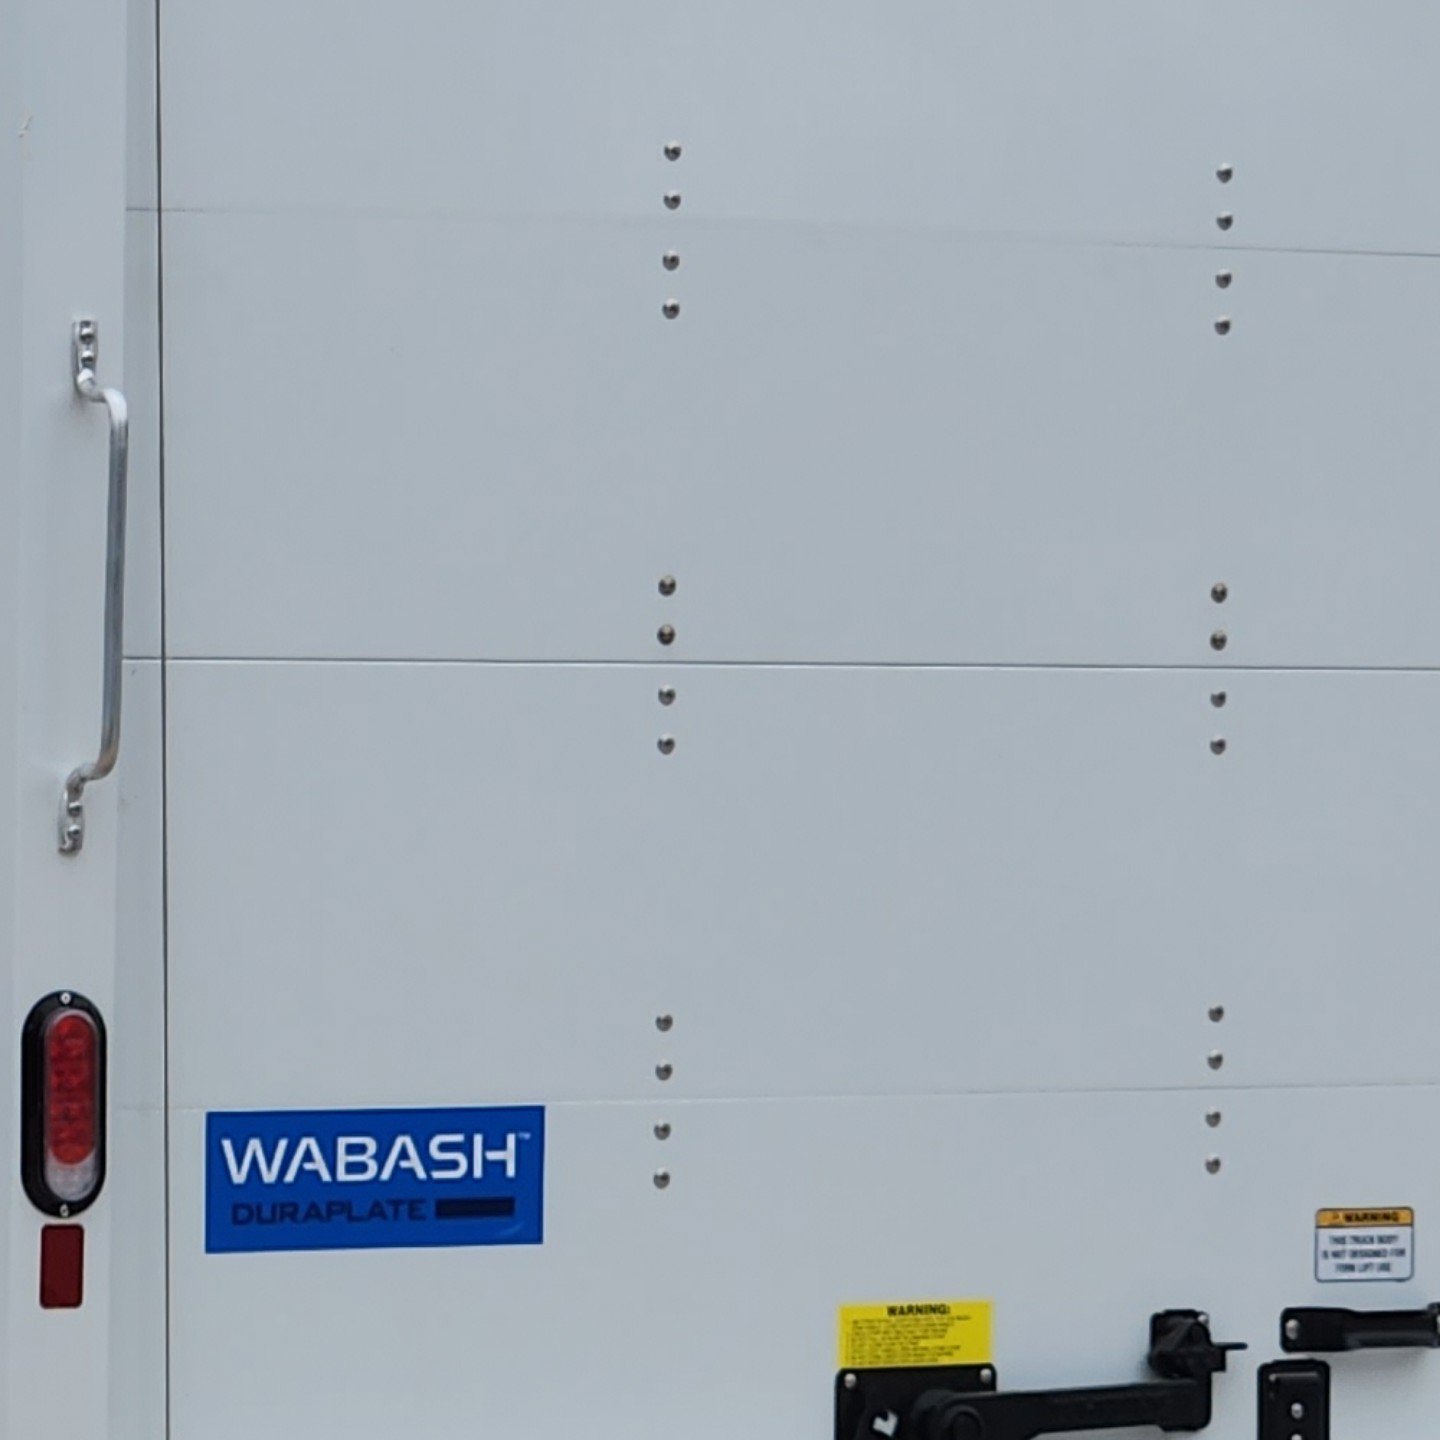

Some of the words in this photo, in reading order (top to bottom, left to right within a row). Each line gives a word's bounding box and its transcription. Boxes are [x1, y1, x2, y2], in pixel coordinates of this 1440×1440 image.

[221, 1133, 517, 1185] WABASH
[231, 1198, 427, 1226] DURAPLATE
[1343, 1211, 1401, 1223] WARNING
